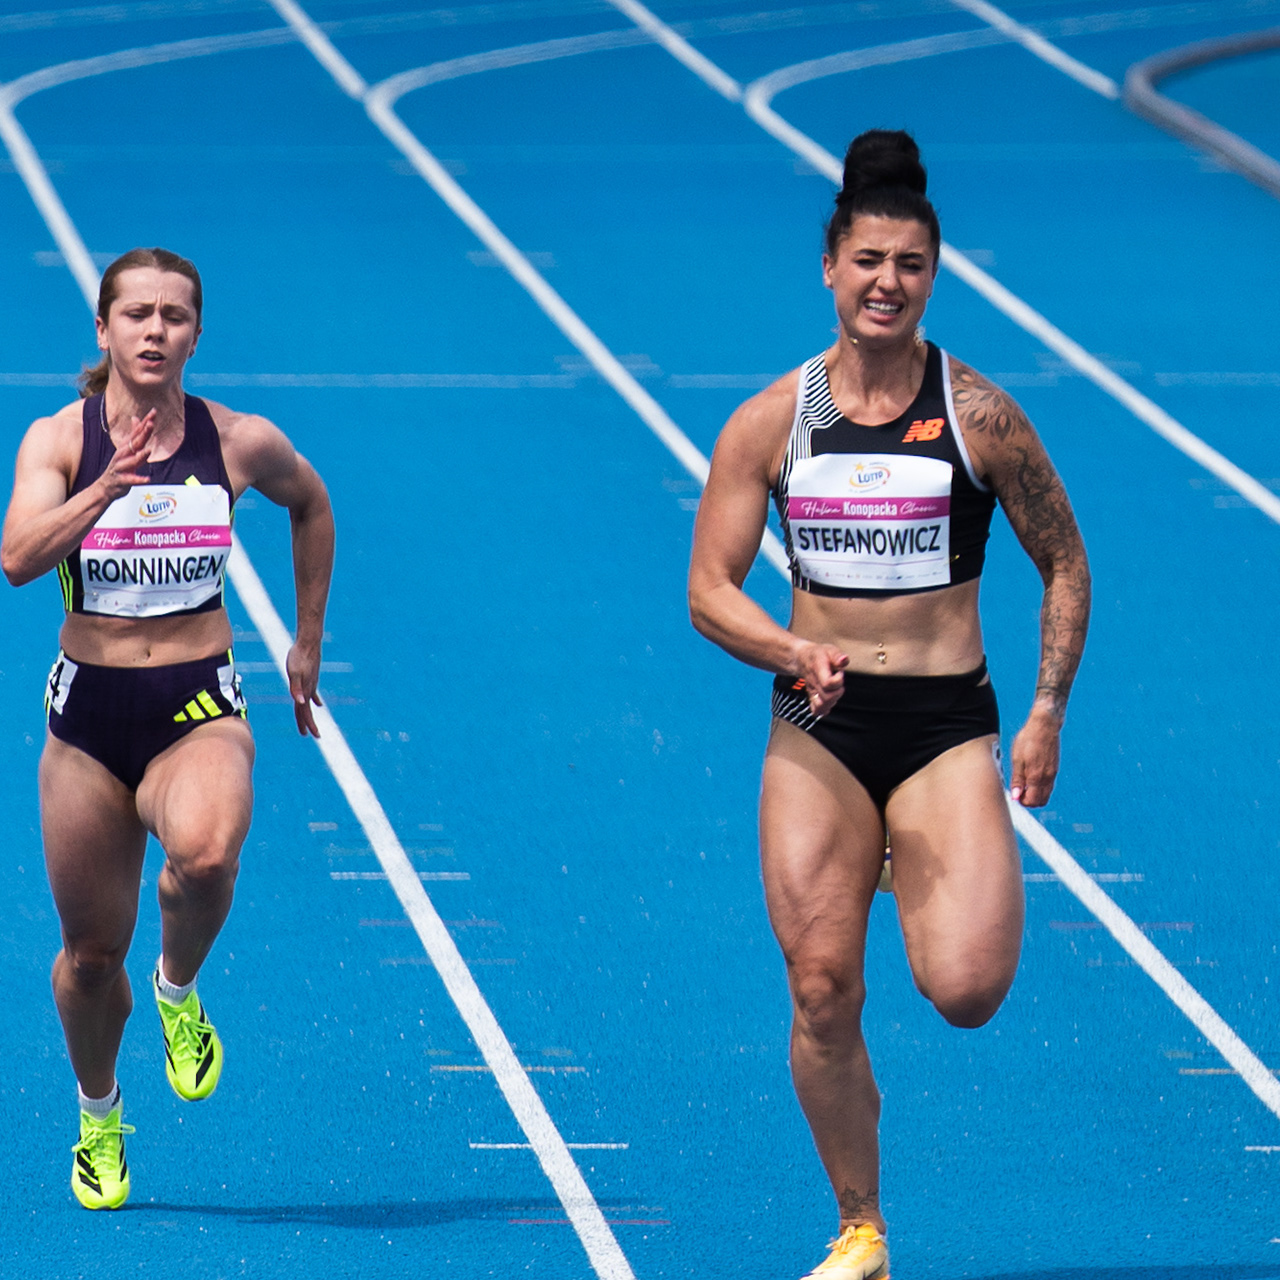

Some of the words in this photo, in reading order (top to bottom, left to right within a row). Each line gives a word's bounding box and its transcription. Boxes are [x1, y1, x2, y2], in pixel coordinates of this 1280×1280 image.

[858, 470, 884, 484] LOTTO
[146, 500, 171, 514] LOTTO
[800, 501, 841, 518] Halina
[843, 501, 898, 518] Konopacka
[94, 531, 132, 548] Halina
[134, 529, 186, 547] Konopacka
[797, 525, 941, 557] STEFANOWICZ
[86, 554, 224, 586] RONNINGEN
